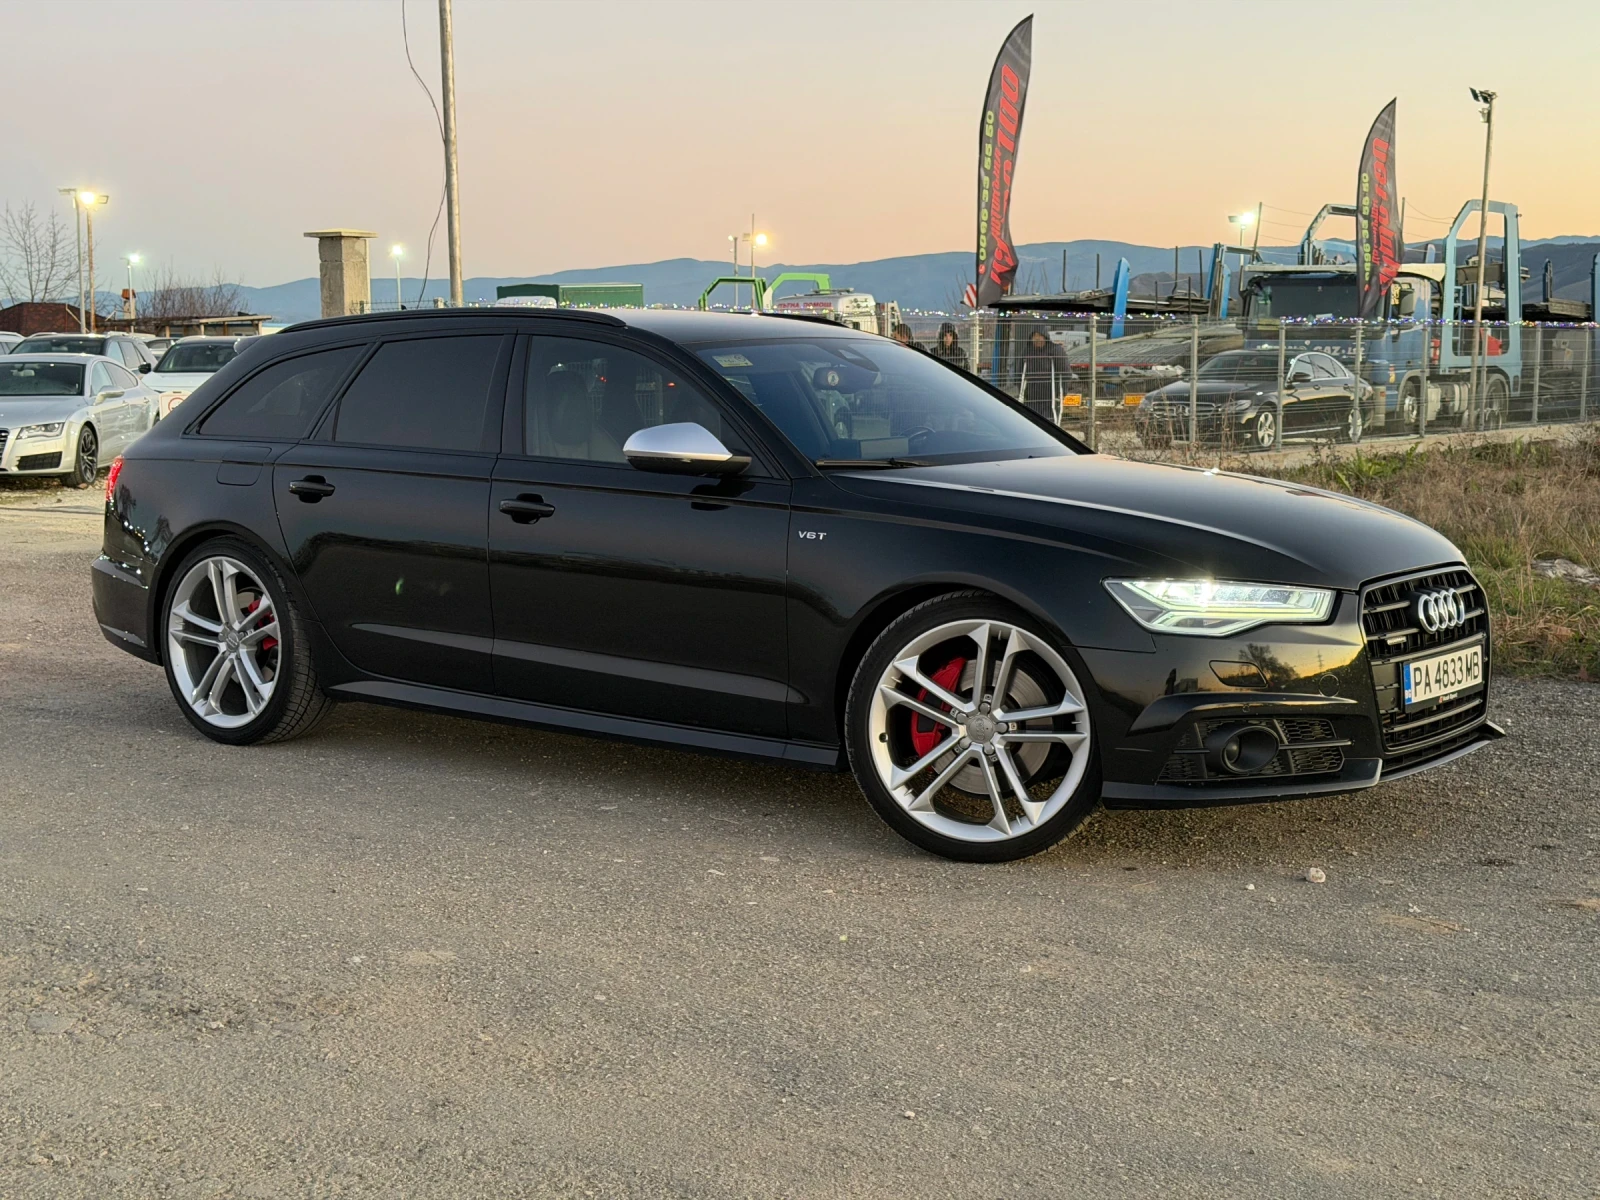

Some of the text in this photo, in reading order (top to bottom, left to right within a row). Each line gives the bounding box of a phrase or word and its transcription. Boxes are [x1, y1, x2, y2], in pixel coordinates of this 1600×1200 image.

[985, 110, 994, 138] 50
[998, 64, 1019, 152] 100
[1413, 651, 1480, 697] PA 4833 MB
